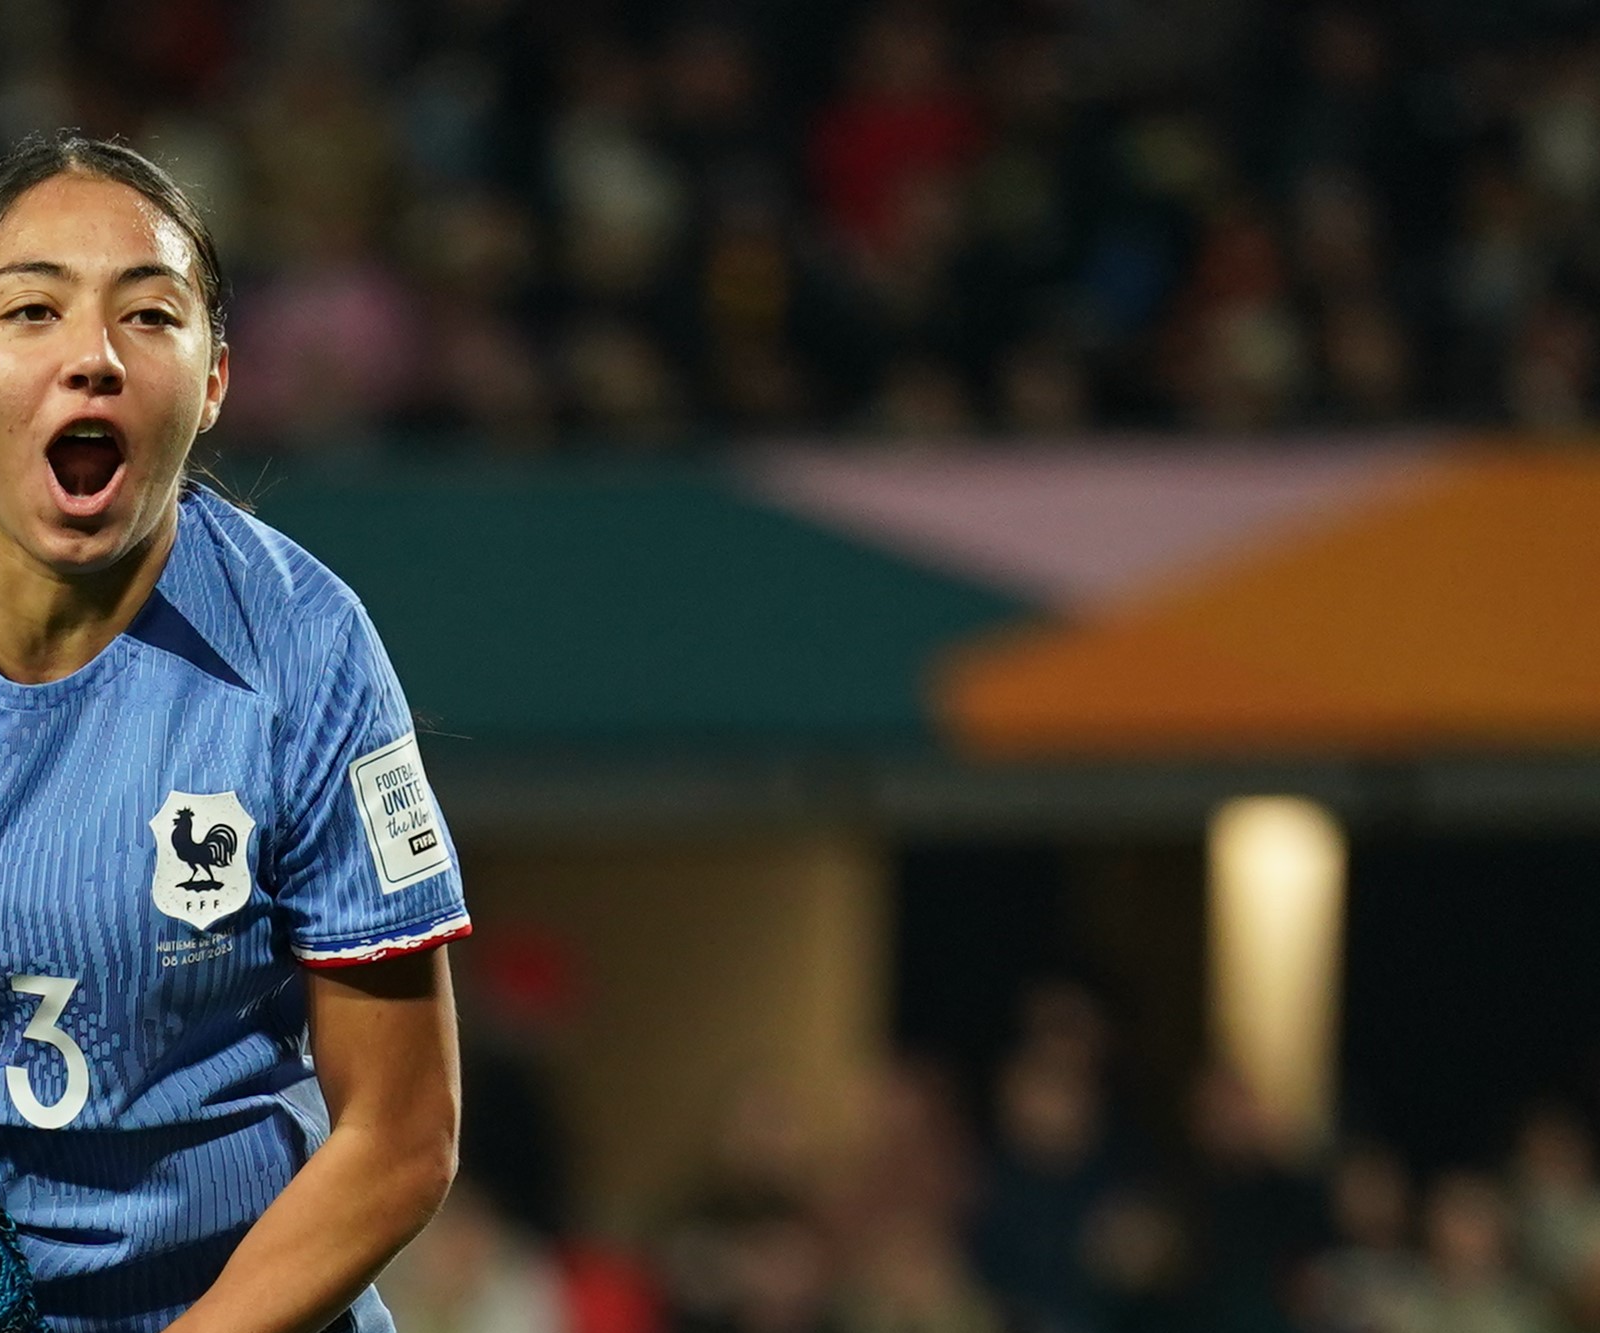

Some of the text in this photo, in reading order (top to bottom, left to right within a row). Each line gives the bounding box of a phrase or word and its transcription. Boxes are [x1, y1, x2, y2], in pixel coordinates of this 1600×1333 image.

[375, 763, 418, 792] FOOTBA
[381, 781, 425, 816] UNITE
[385, 817, 410, 839] the
[411, 833, 437, 852] FIFA
[162, 956, 179, 967] 08
[207, 940, 234, 959] 2023
